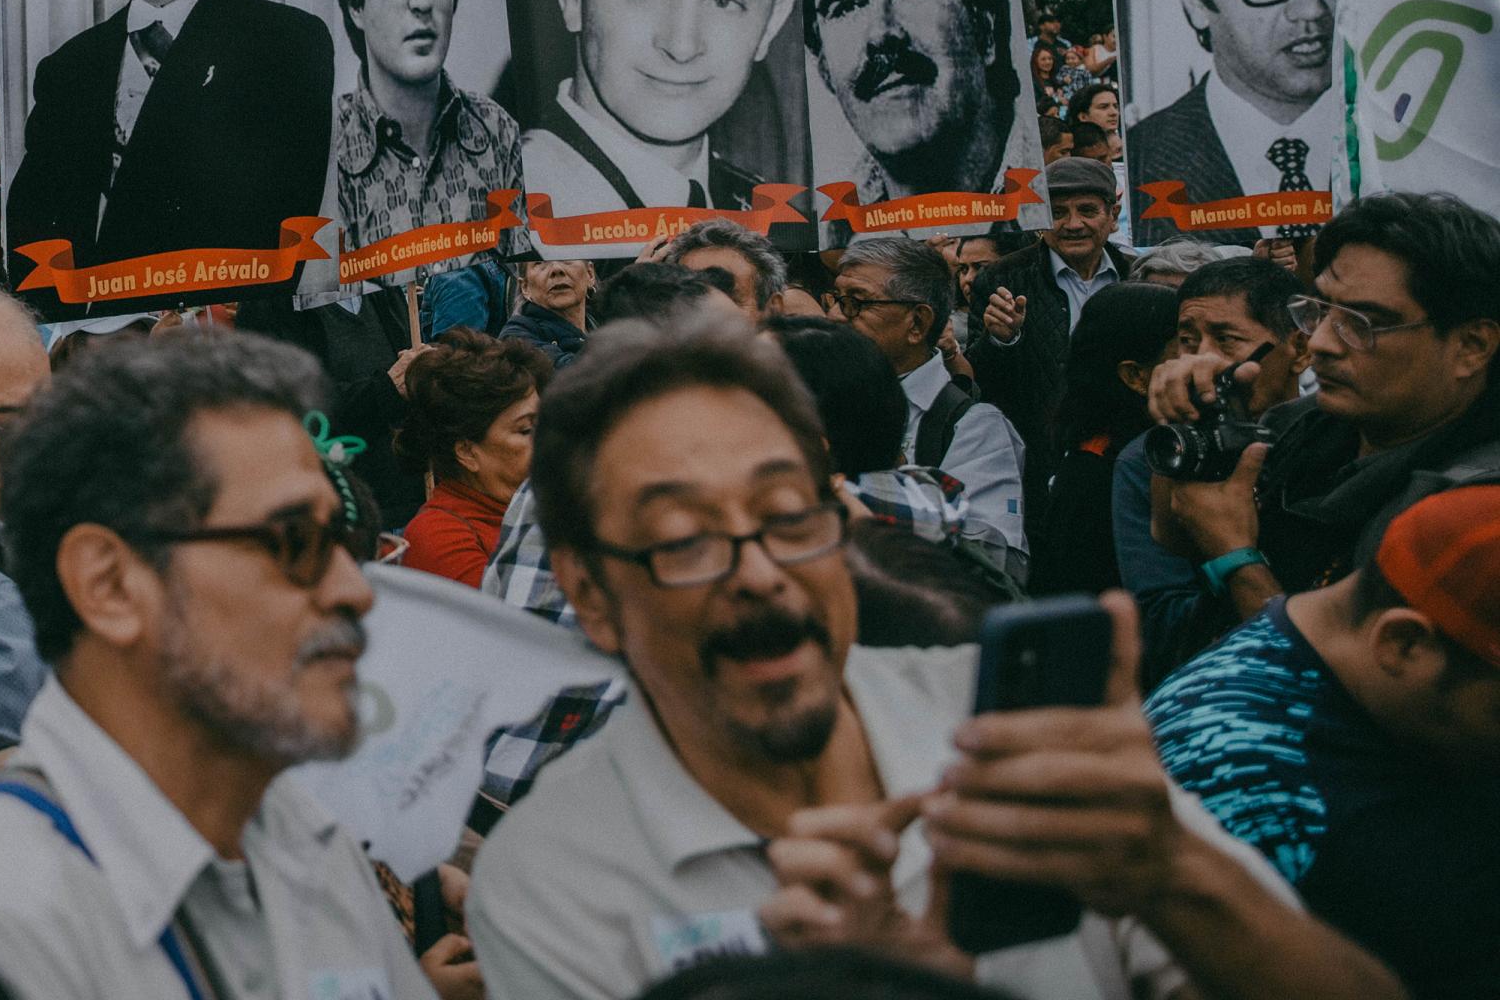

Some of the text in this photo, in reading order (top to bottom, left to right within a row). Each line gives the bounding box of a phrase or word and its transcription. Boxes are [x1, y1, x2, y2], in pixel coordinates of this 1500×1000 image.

[865, 199, 1006, 228] Alberto Fuentes Mohr
[1190, 203, 1252, 226] Manuel
[1256, 200, 1307, 218] Colom
[582, 218, 649, 242] Jacobo
[340, 226, 496, 279] Oliverio Castañeda de león
[87, 257, 270, 299] Juan José Arévalo
